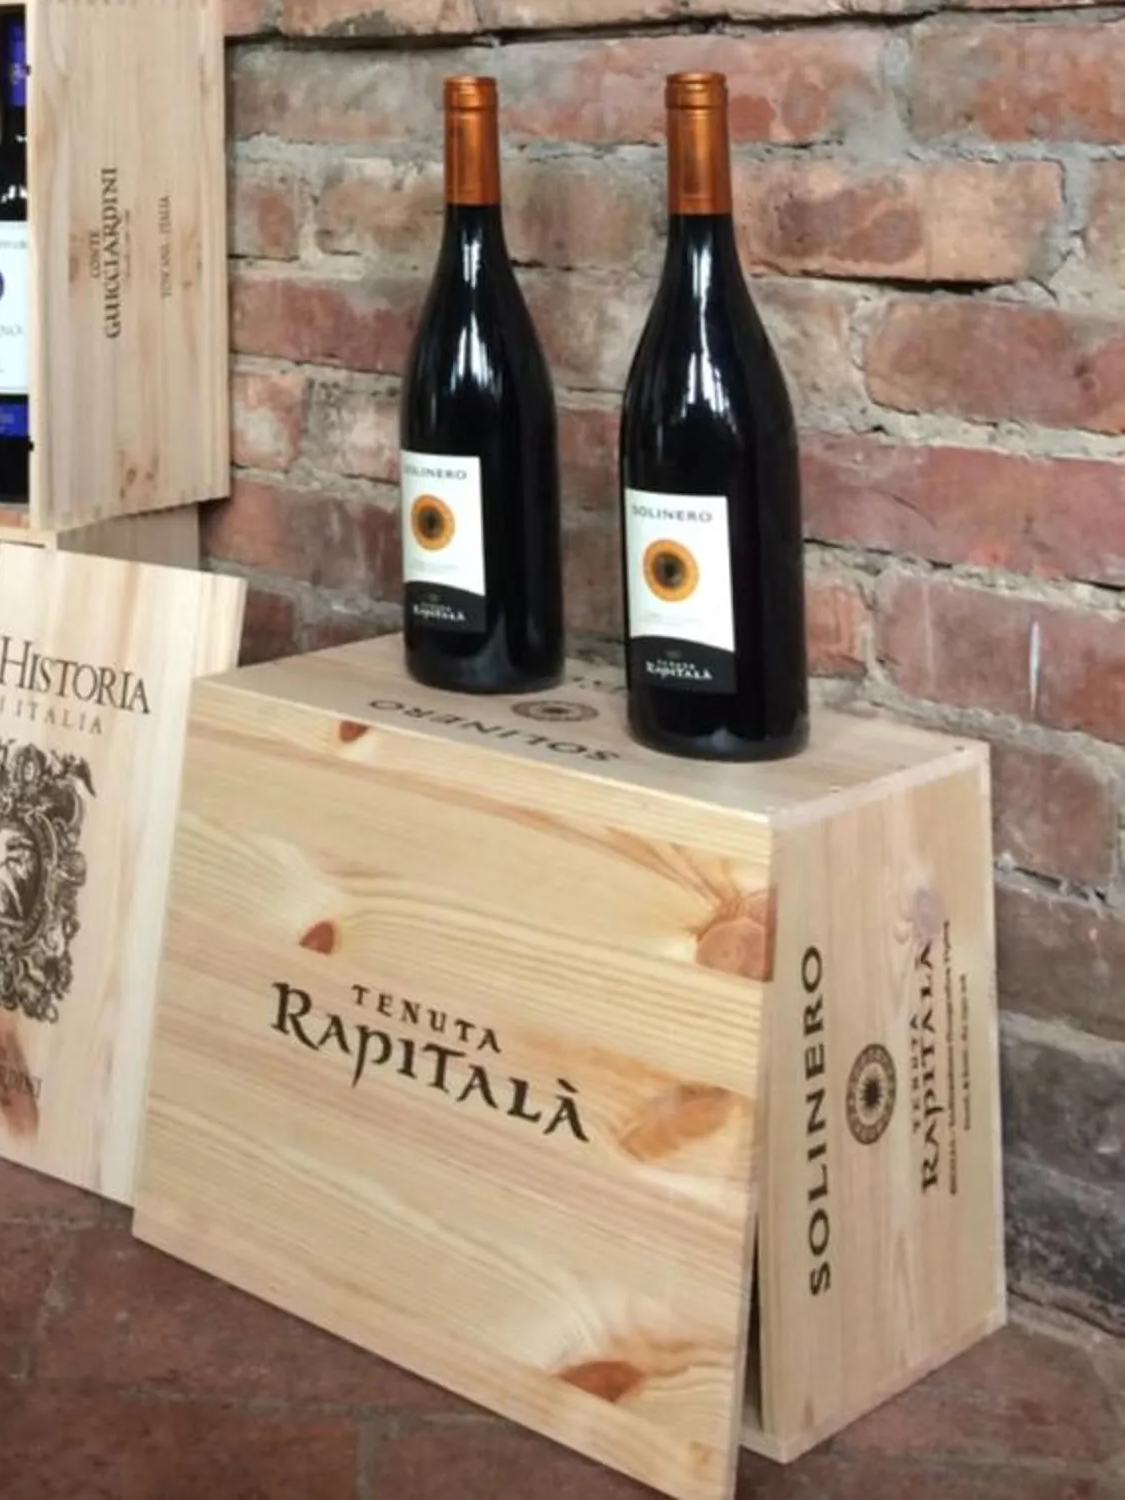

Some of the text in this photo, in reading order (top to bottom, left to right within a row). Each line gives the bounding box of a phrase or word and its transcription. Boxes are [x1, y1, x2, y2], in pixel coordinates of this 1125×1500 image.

[88, 229, 101, 279] CONTE
[101, 167, 122, 339] GUICCIARDINI
[631, 504, 714, 524] SOLINERO
[16, 699, 103, 735] ITALIA
[369, 700, 621, 762] SOLINERO
[351, 983, 502, 1054] TENUTA
[909, 1014, 920, 1135] TENUTA
[801, 946, 832, 1297] SOLINERO
